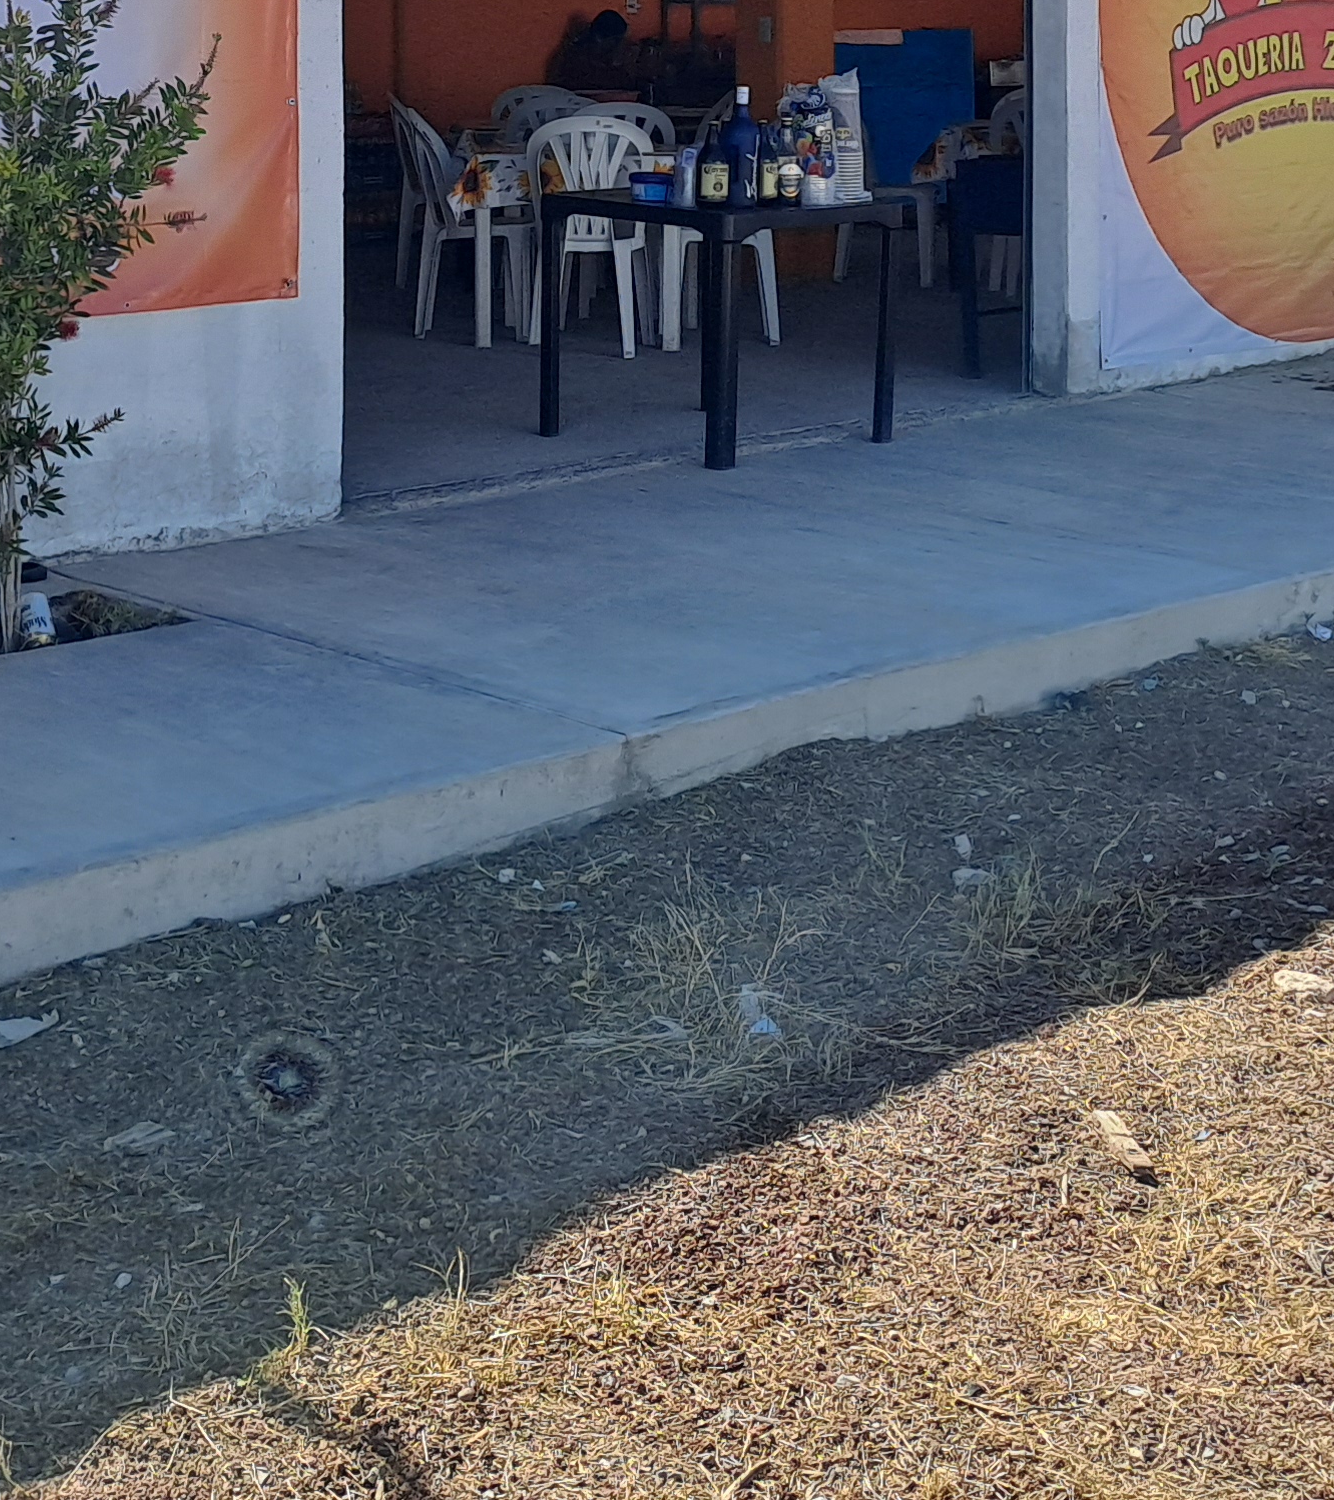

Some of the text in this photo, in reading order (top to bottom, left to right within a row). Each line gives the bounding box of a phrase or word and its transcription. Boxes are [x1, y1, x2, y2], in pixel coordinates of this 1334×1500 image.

[1183, 31, 1305, 105] TAQUERIA
[1213, 113, 1255, 149] Puro
[1259, 99, 1309, 131] sazón
